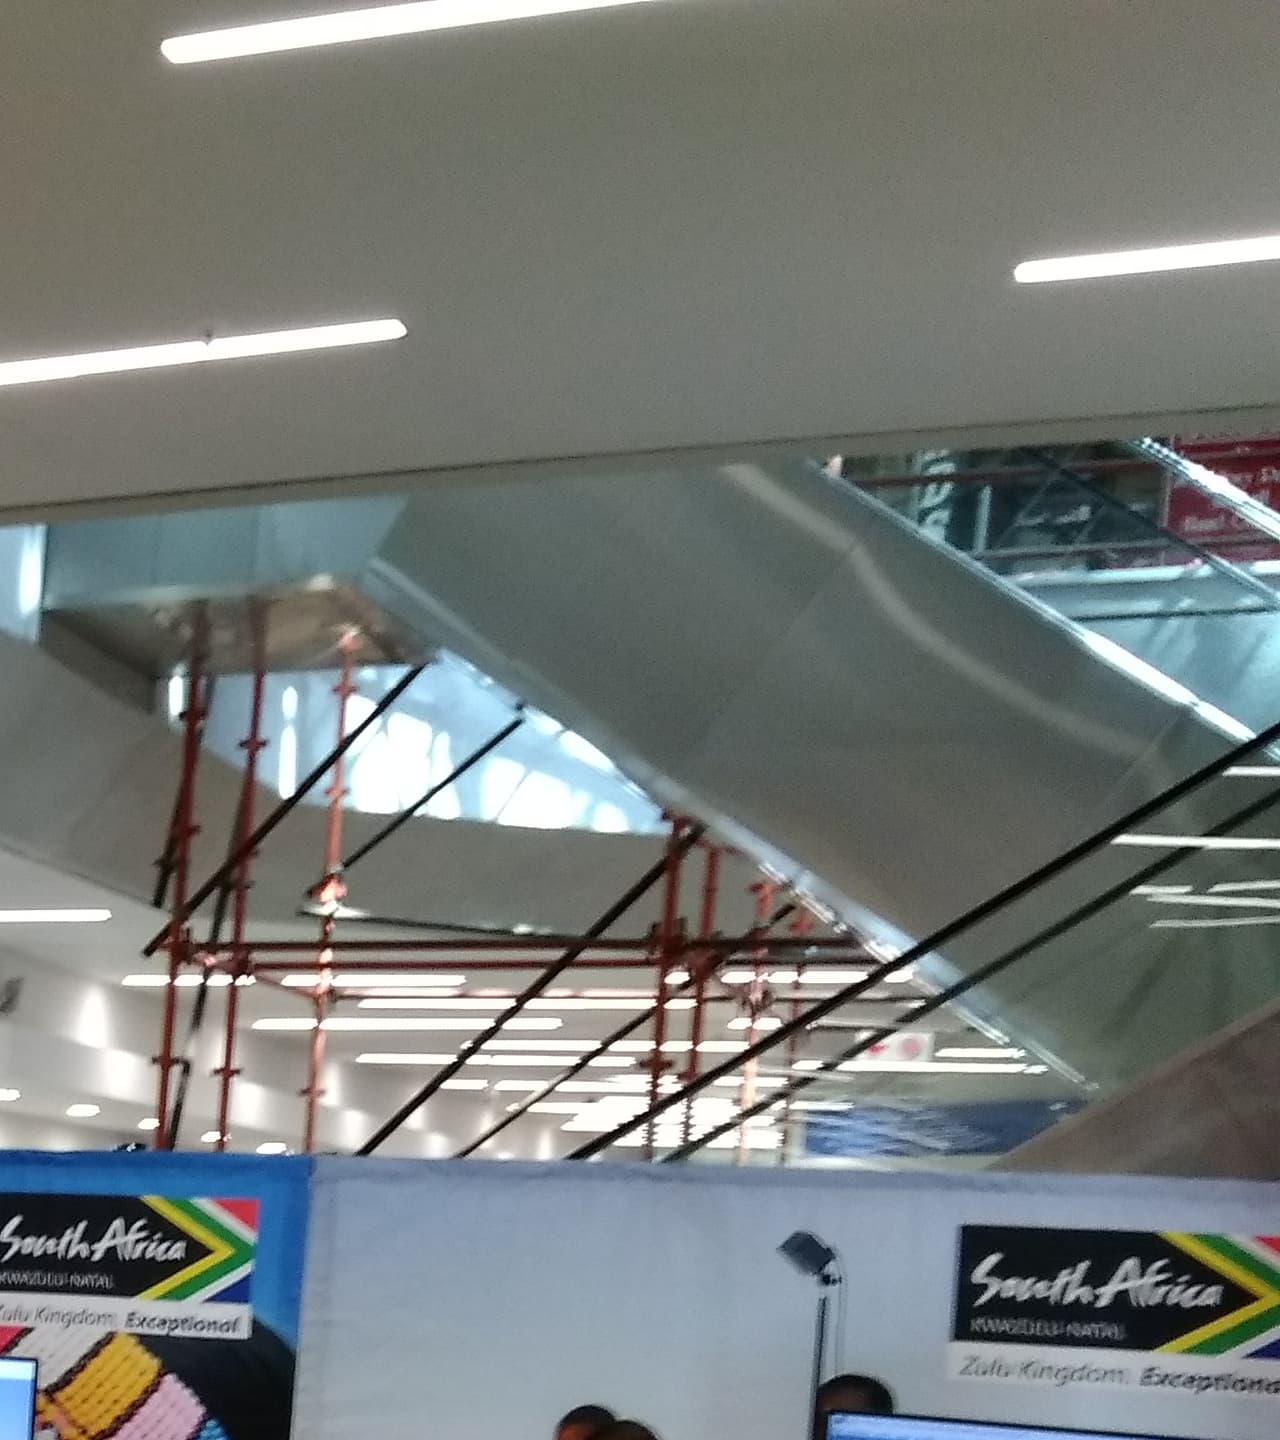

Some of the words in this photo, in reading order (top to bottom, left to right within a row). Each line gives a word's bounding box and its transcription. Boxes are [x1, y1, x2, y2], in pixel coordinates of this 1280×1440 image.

[88, 1216, 188, 1263] Africa
[970, 1251, 1095, 1308] South
[1093, 1255, 1226, 1309] Africa
[123, 1311, 240, 1337] Exceptional
[969, 1315, 1130, 1343] KWAZULU-NATAL
[958, 1355, 1012, 1378] Zulu
[1138, 1365, 1280, 1396] Exceptiona
